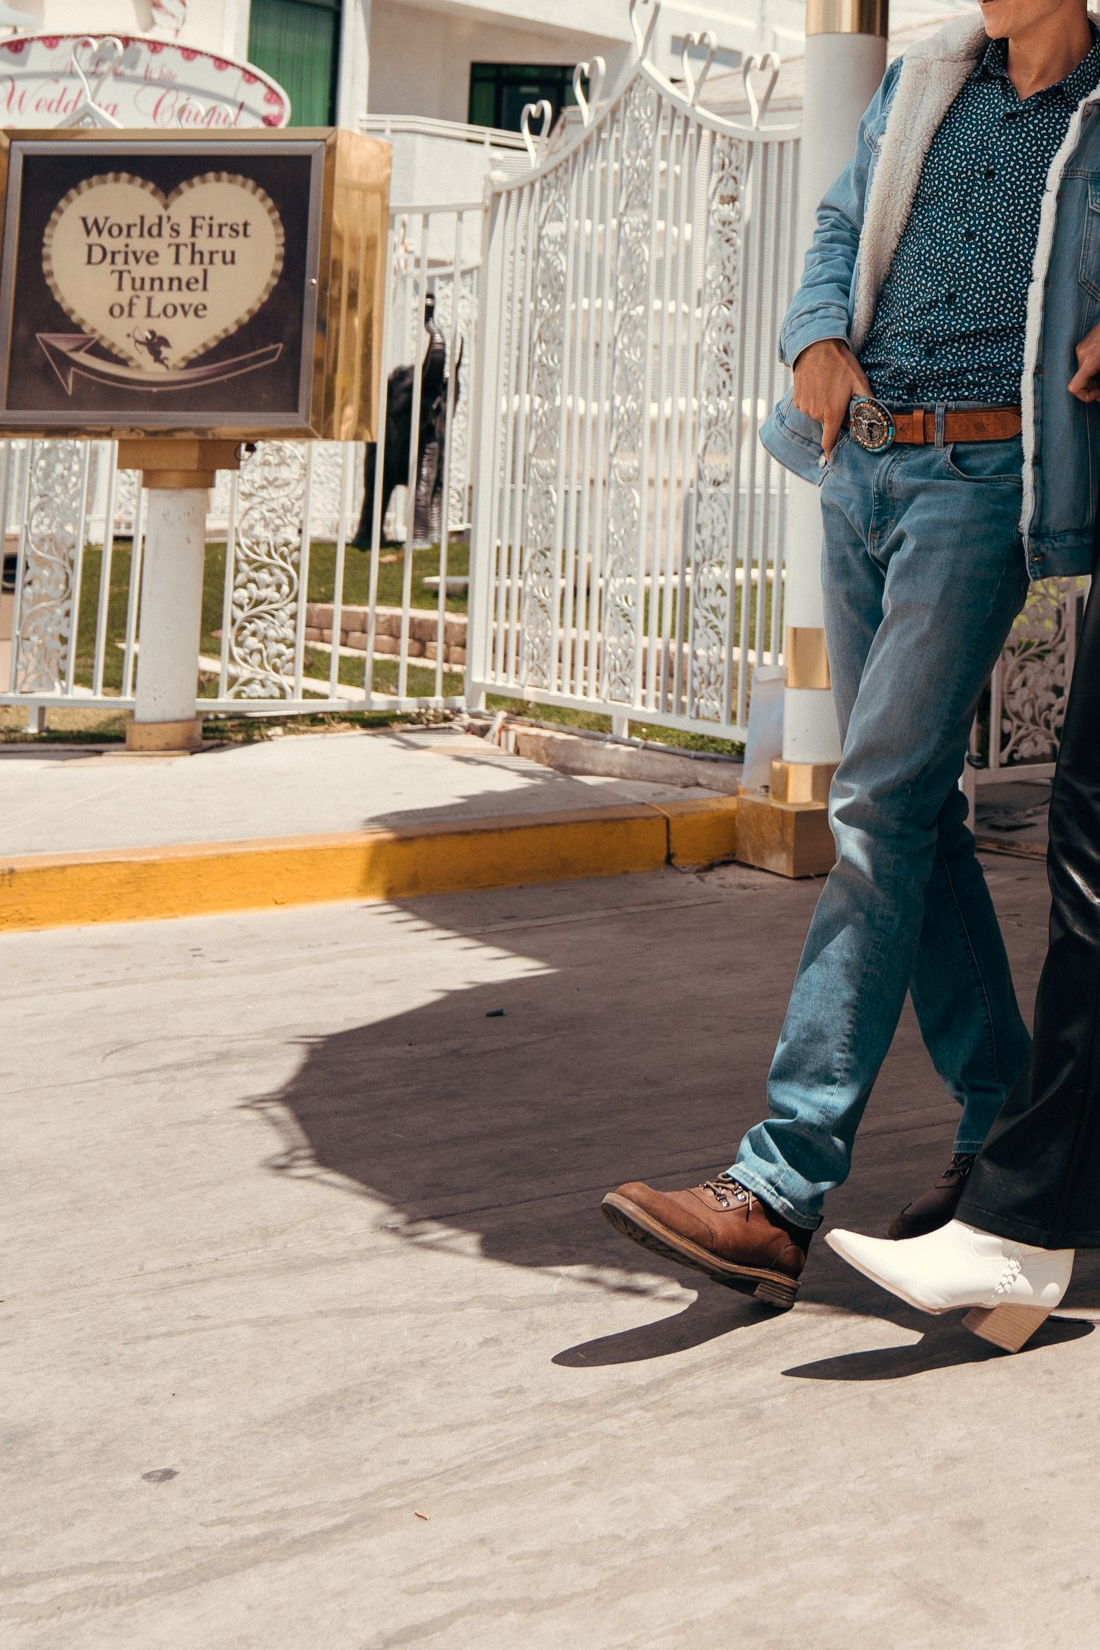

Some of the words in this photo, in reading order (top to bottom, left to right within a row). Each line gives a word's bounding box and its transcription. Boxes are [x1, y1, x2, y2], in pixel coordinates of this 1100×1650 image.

[0, 74, 119, 117] Weddg
[79, 214, 181, 239] World's
[188, 215, 252, 239] First
[85, 243, 160, 266] Drive
[167, 242, 237, 266] Thru
[110, 268, 209, 292] Tunnel
[108, 294, 141, 319] of
[144, 295, 208, 319] Love
